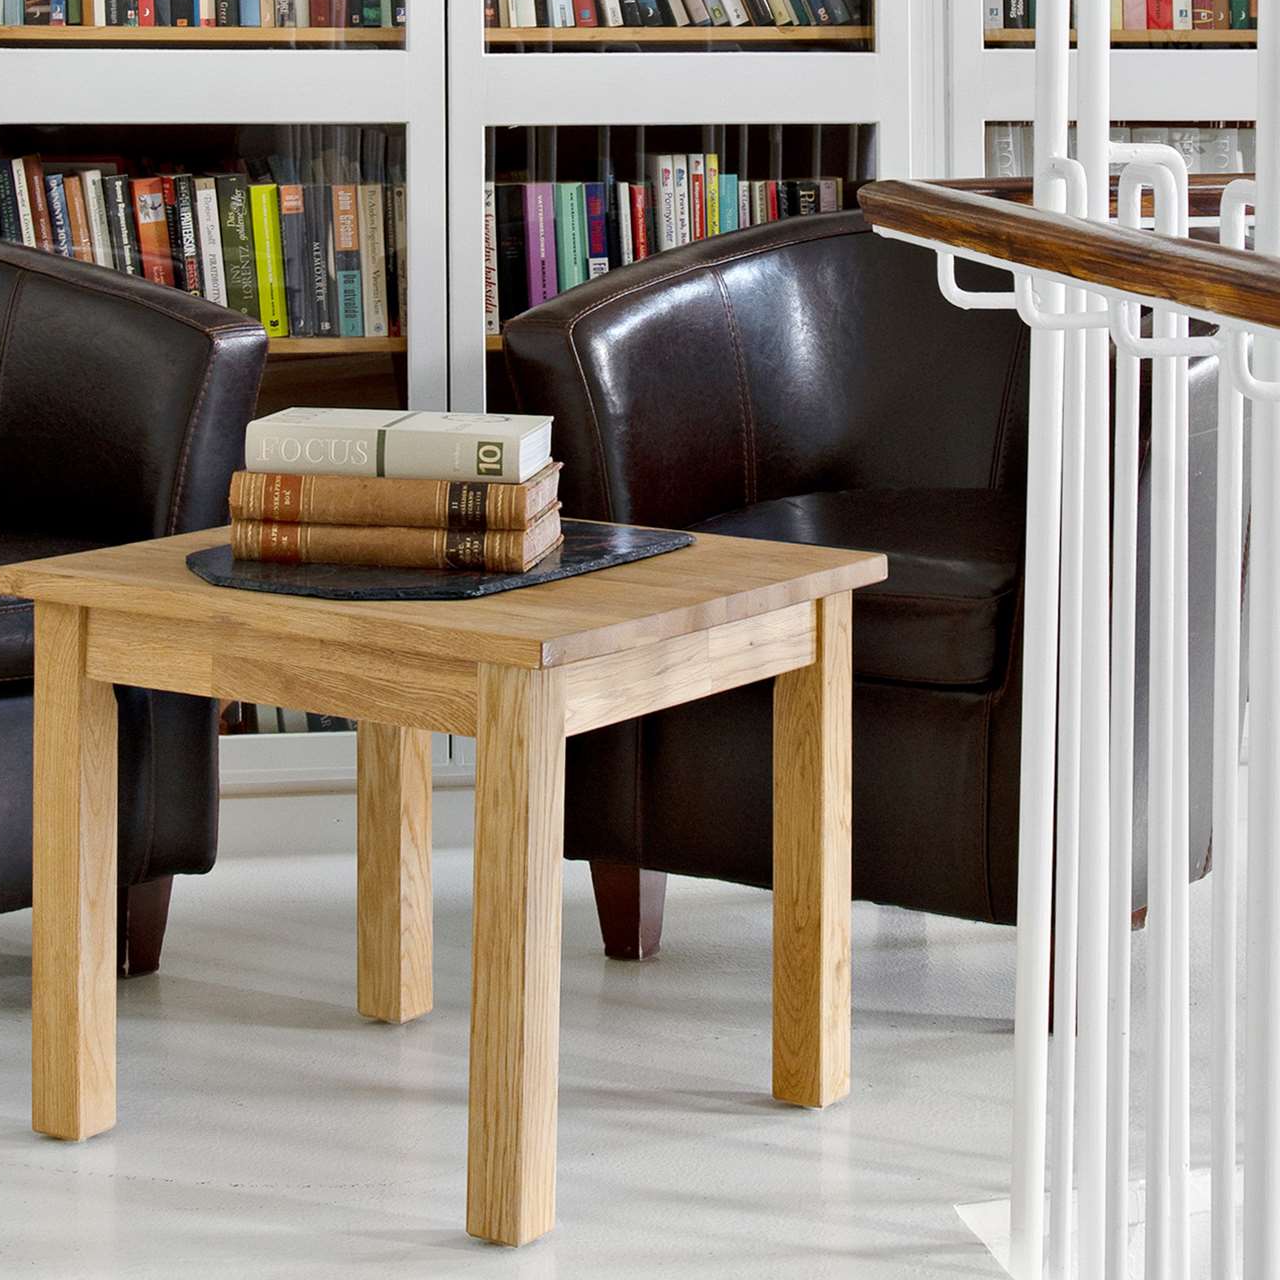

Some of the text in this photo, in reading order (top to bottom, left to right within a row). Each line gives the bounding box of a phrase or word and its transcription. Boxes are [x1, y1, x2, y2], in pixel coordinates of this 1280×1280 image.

[664, 192, 674, 242] Ponnyvinter
[180, 212, 199, 288] PATTERSON CROSS
[230, 263, 239, 282] INY
[239, 245, 251, 300] LORENTZ
[312, 241, 323, 302] MEMOARER
[485, 265, 499, 314] baksida
[256, 438, 369, 466] FOCUS
[479, 445, 500, 472] 10
